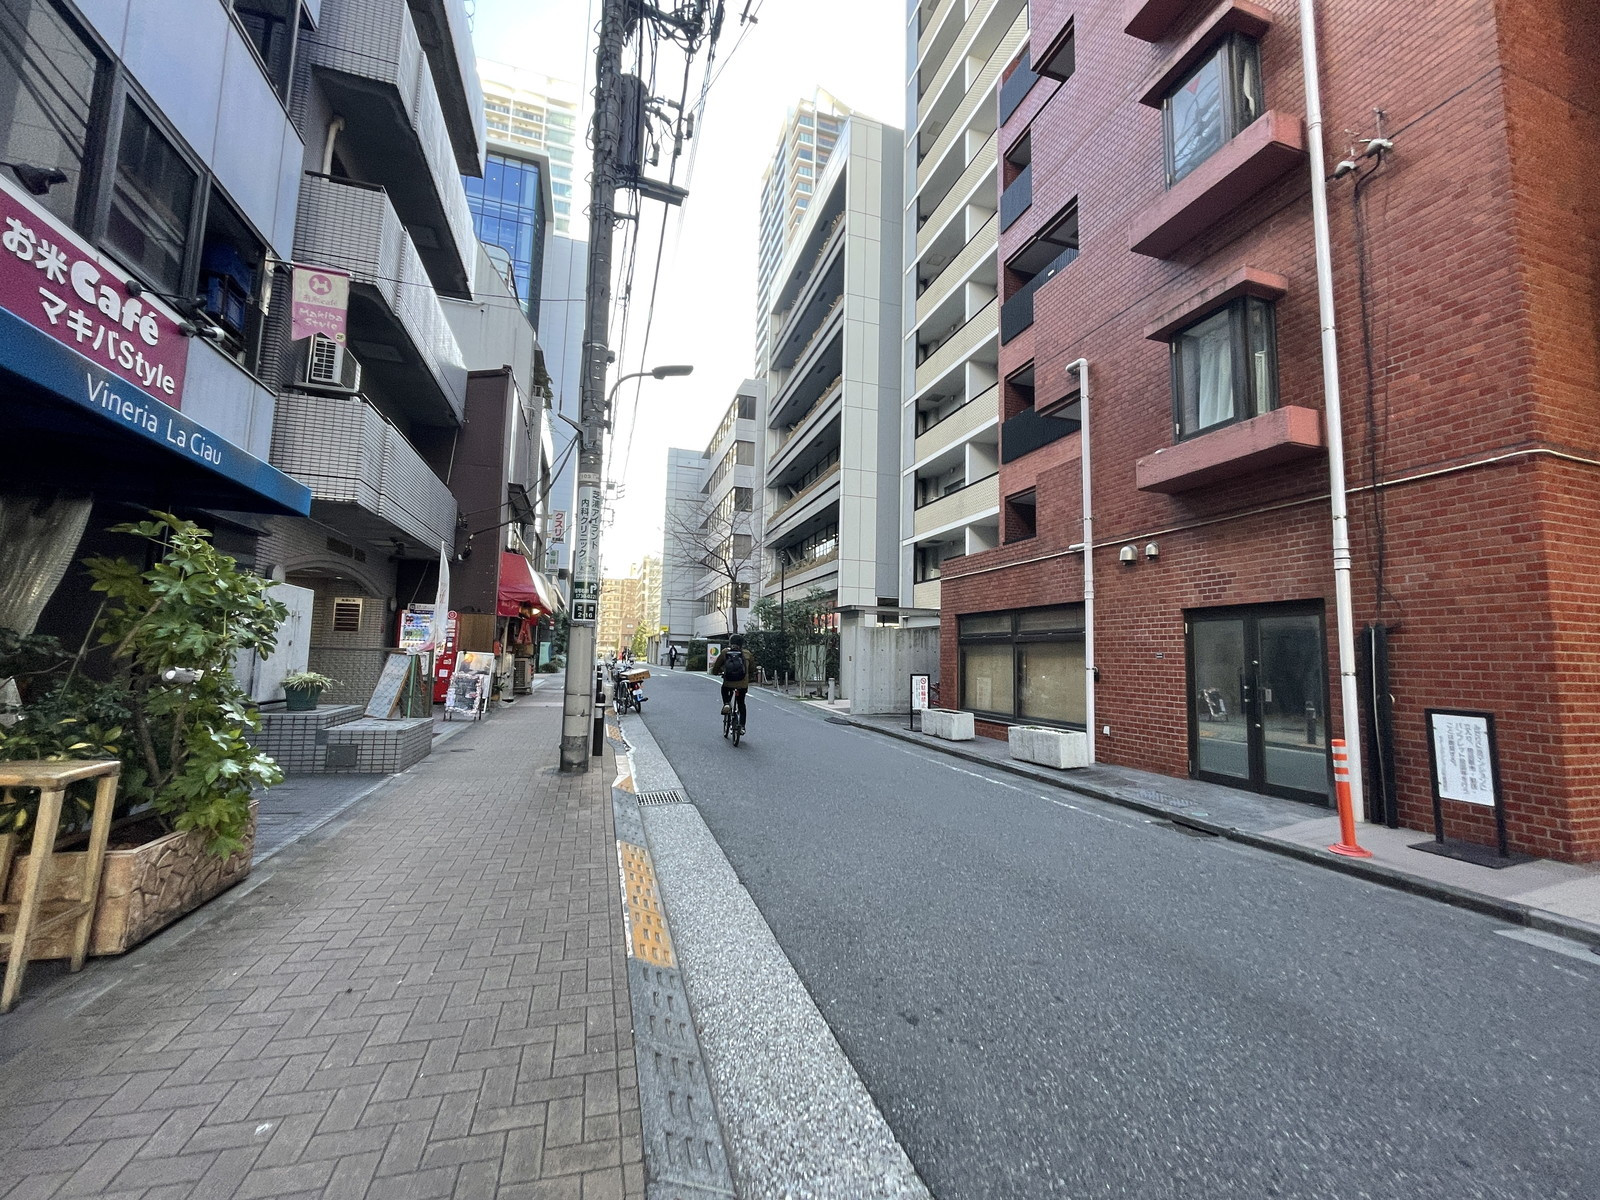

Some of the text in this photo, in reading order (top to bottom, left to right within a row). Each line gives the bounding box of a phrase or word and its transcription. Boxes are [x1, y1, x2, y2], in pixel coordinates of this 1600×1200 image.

[87, 372, 222, 465] Vineria La Ciau
[555, 512, 564, 537] クスリ
[578, 499, 590, 558] 内科クリニック
